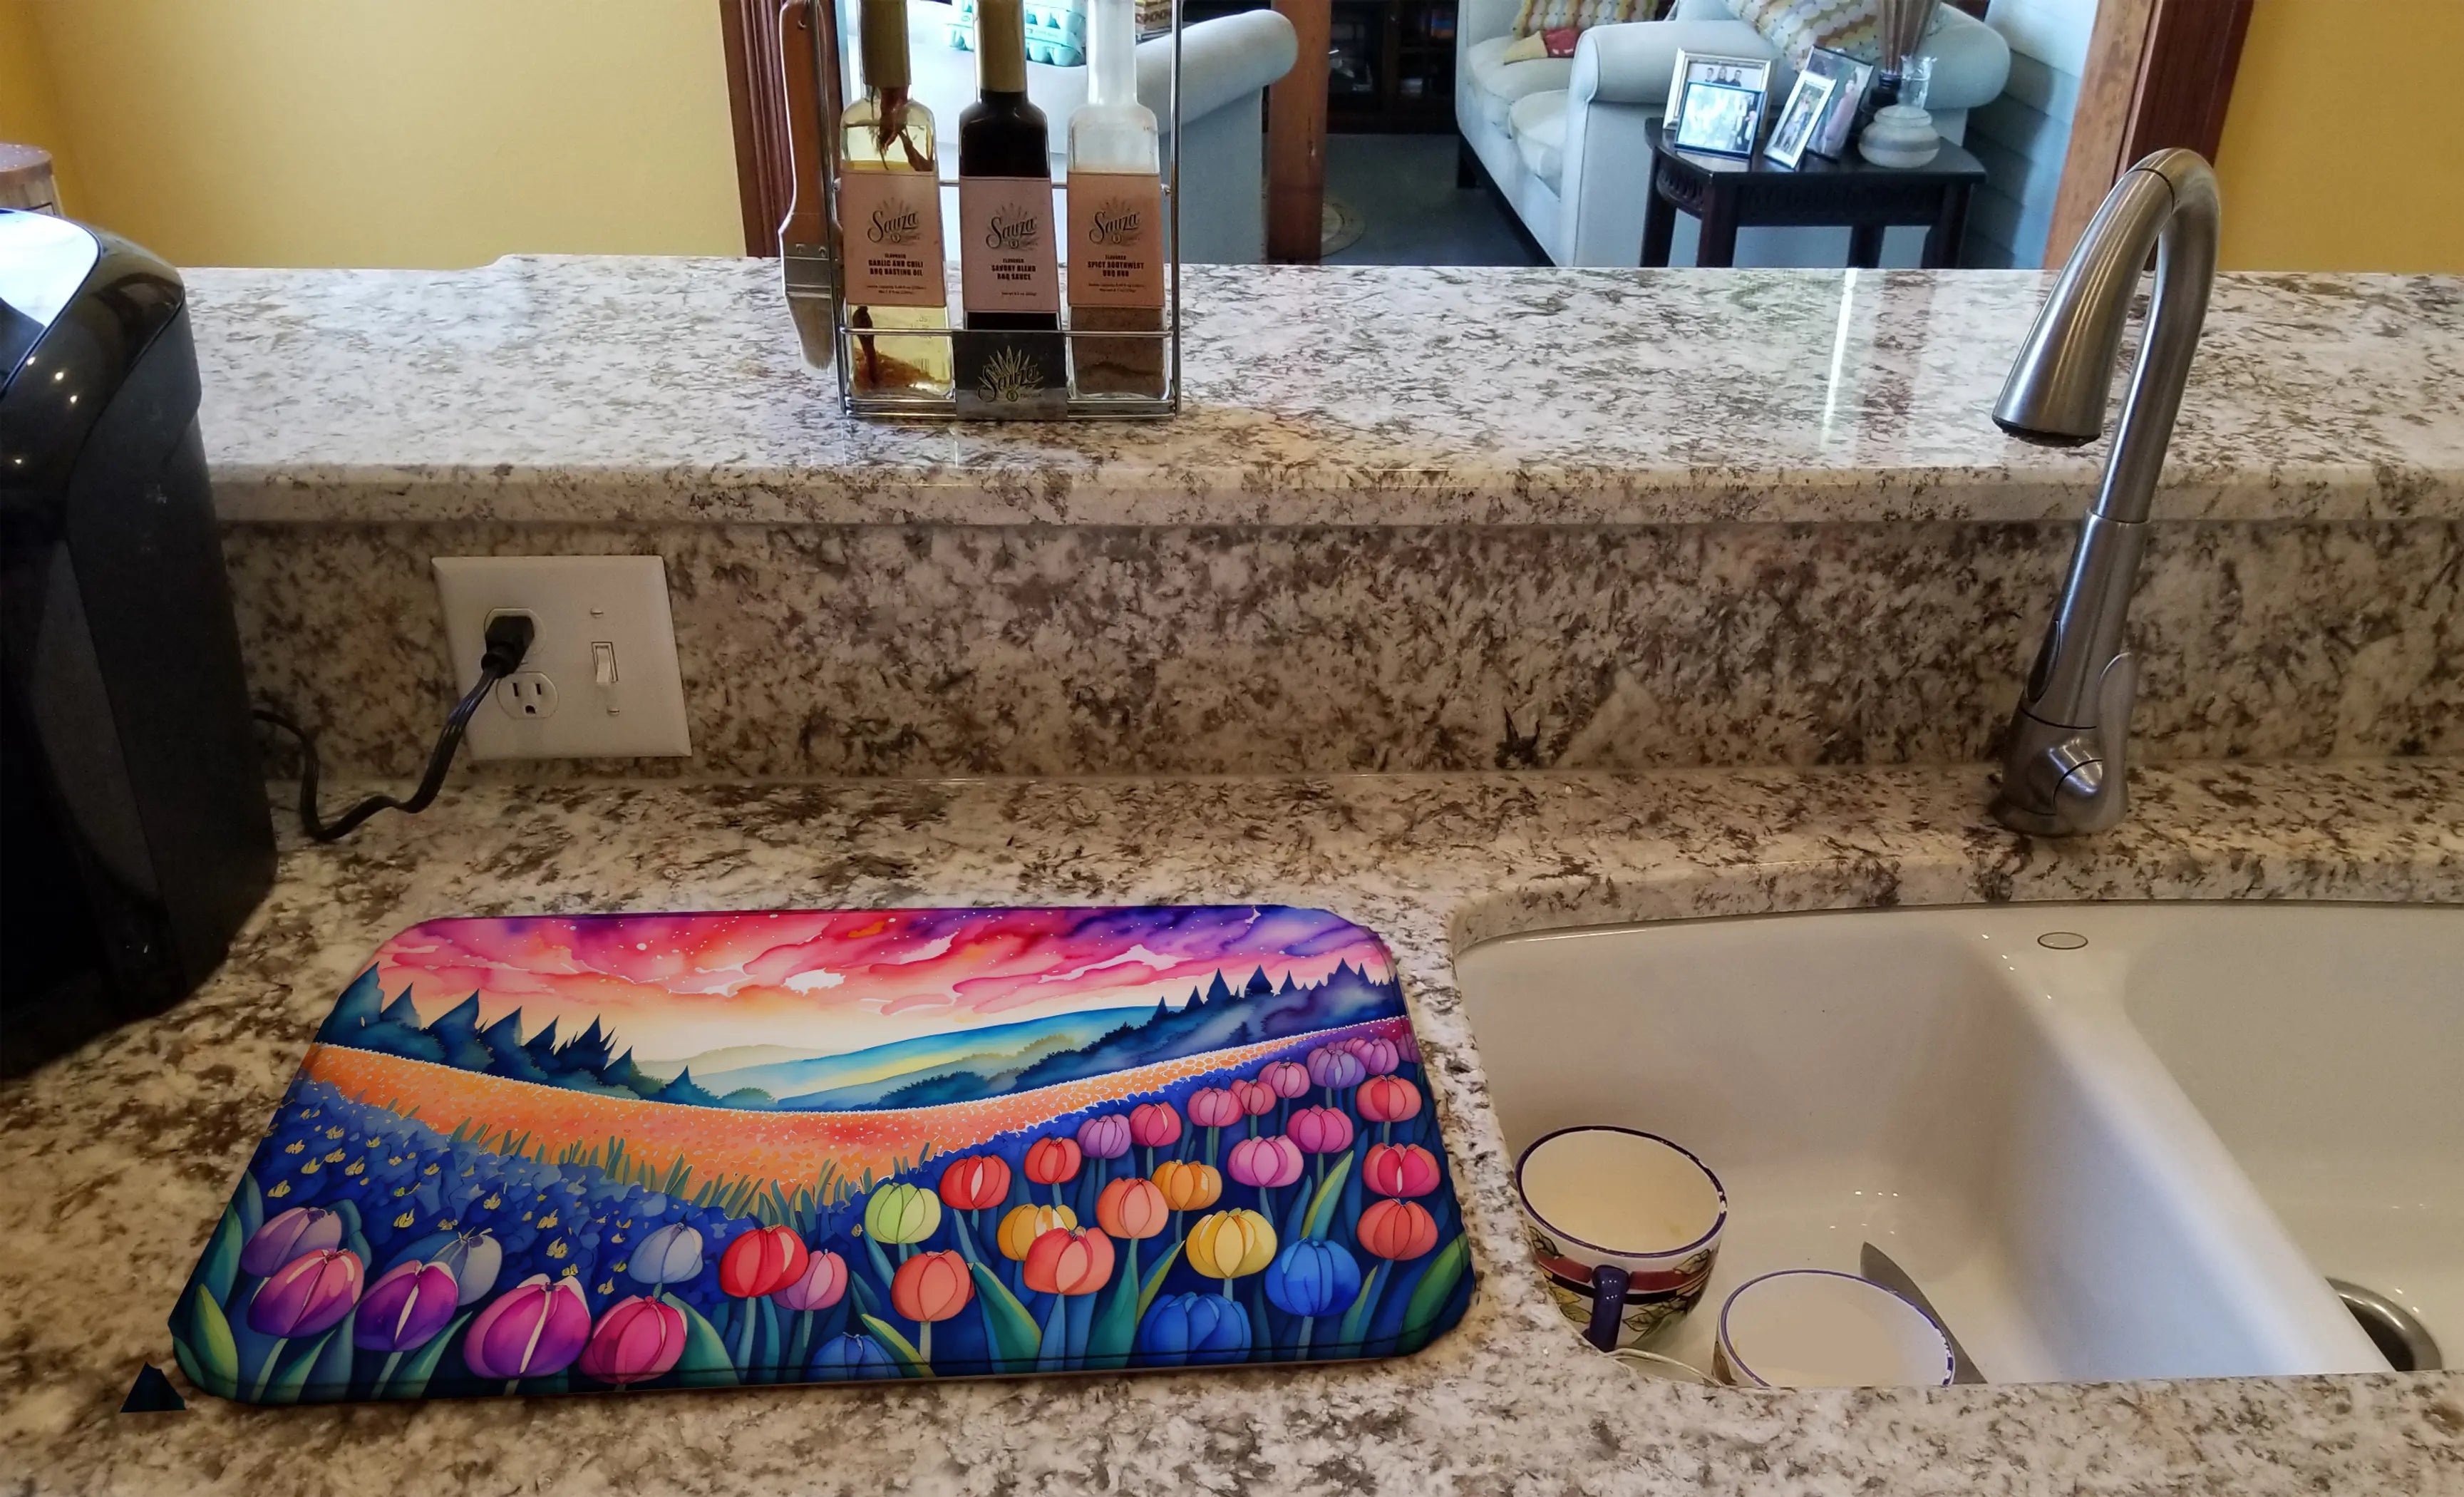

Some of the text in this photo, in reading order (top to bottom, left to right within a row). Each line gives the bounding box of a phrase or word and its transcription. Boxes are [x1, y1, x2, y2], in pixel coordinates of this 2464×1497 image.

[867, 210, 919, 243] Sauza
[986, 216, 1037, 249] Sauza
[1088, 211, 1140, 244] Sauza
[977, 363, 1043, 403] Sauza
